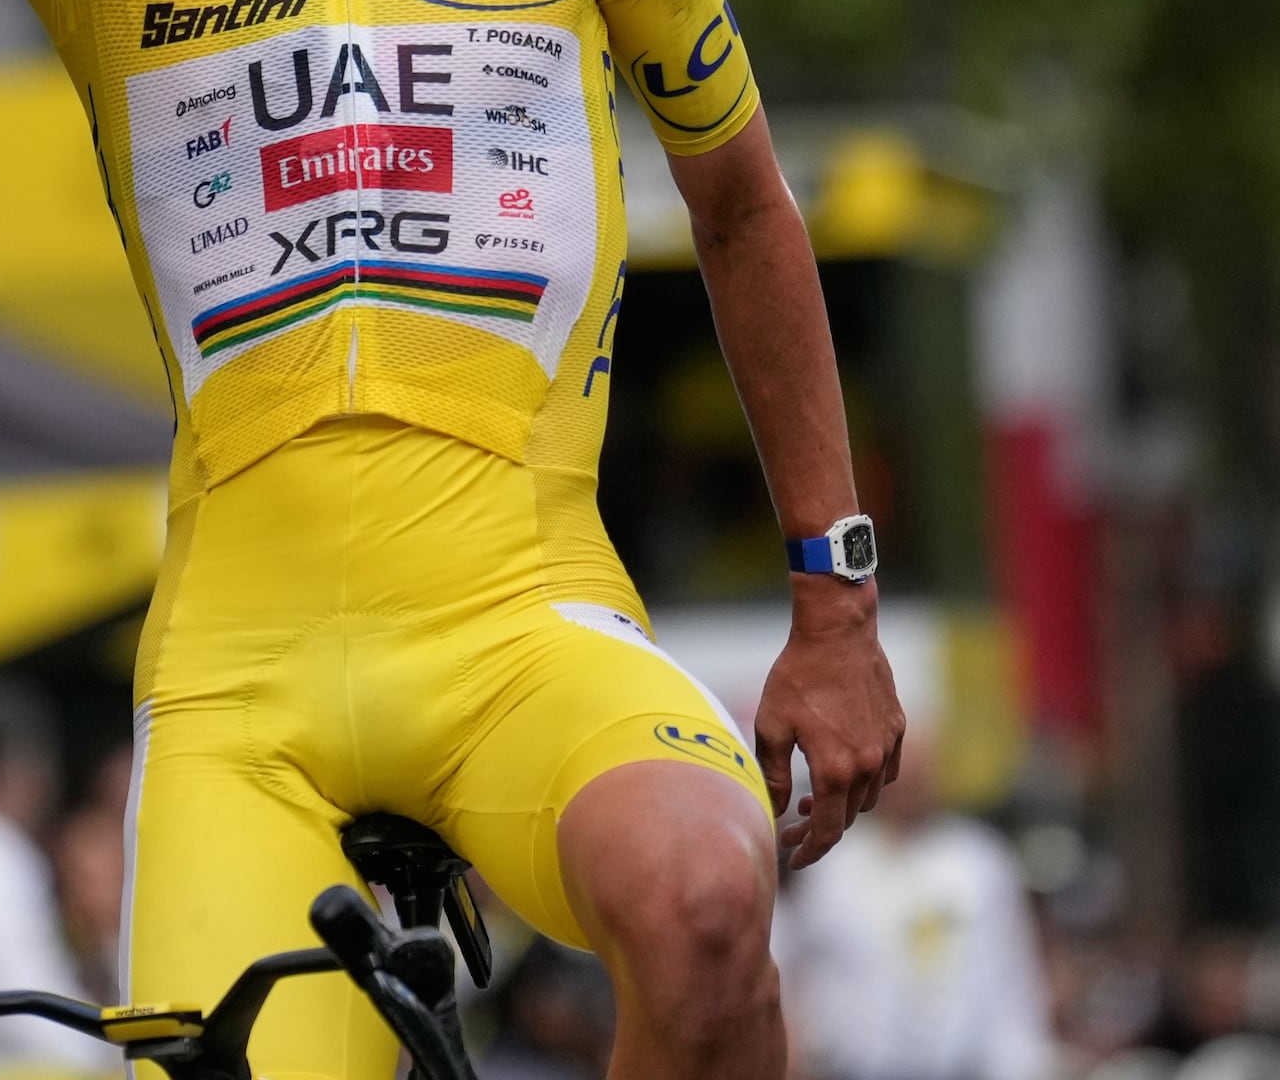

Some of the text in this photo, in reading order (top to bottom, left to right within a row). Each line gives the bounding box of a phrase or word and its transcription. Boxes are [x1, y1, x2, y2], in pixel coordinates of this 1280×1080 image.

[466, 28, 563, 60] T. POGACAR
[248, 43, 454, 131] UAE
[496, 66, 549, 88] COLNAGO
[187, 84, 236, 113] Analog
[278, 142, 435, 189] Emirates
[511, 151, 549, 176] IHC
[193, 171, 233, 208] G42
[268, 210, 451, 276] XRG
[492, 237, 545, 253] PISSEI
[193, 264, 256, 296] RICHARD MILLE
